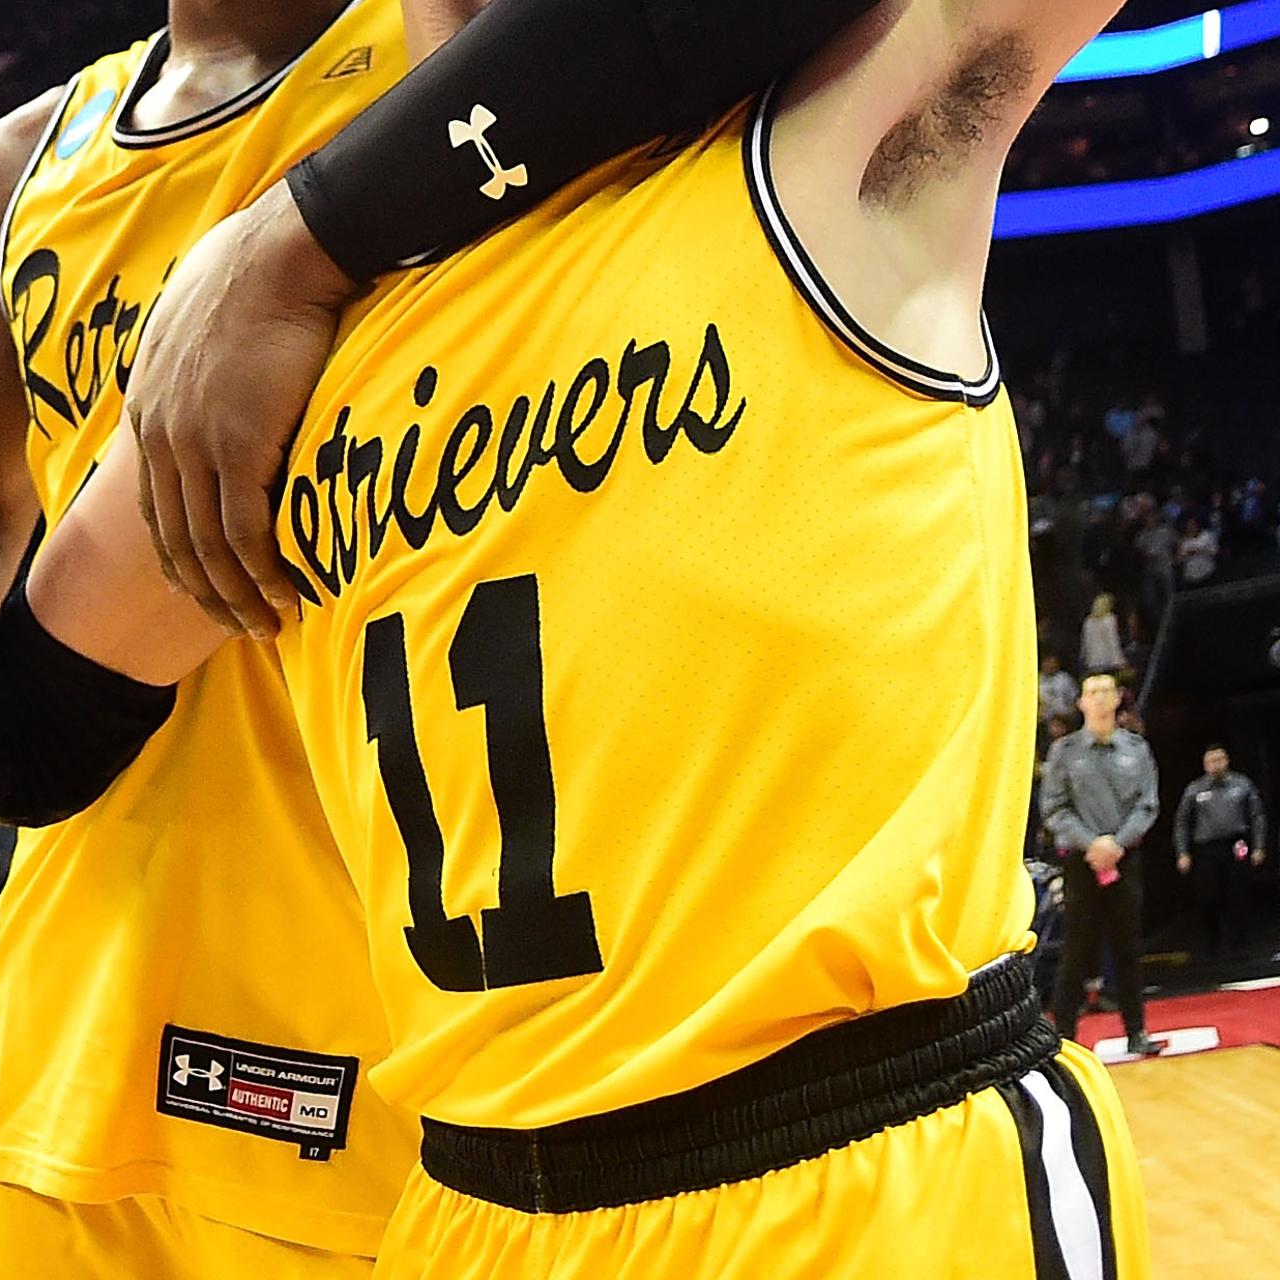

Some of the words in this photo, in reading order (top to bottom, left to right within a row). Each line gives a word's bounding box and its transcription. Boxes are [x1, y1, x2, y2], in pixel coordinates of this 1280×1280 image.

[361, 573, 605, 992] 11
[235, 1062, 276, 1078] UNDER
[277, 1071, 336, 1086] ARMOUR
[231, 1088, 289, 1113] AUTHENTIC
